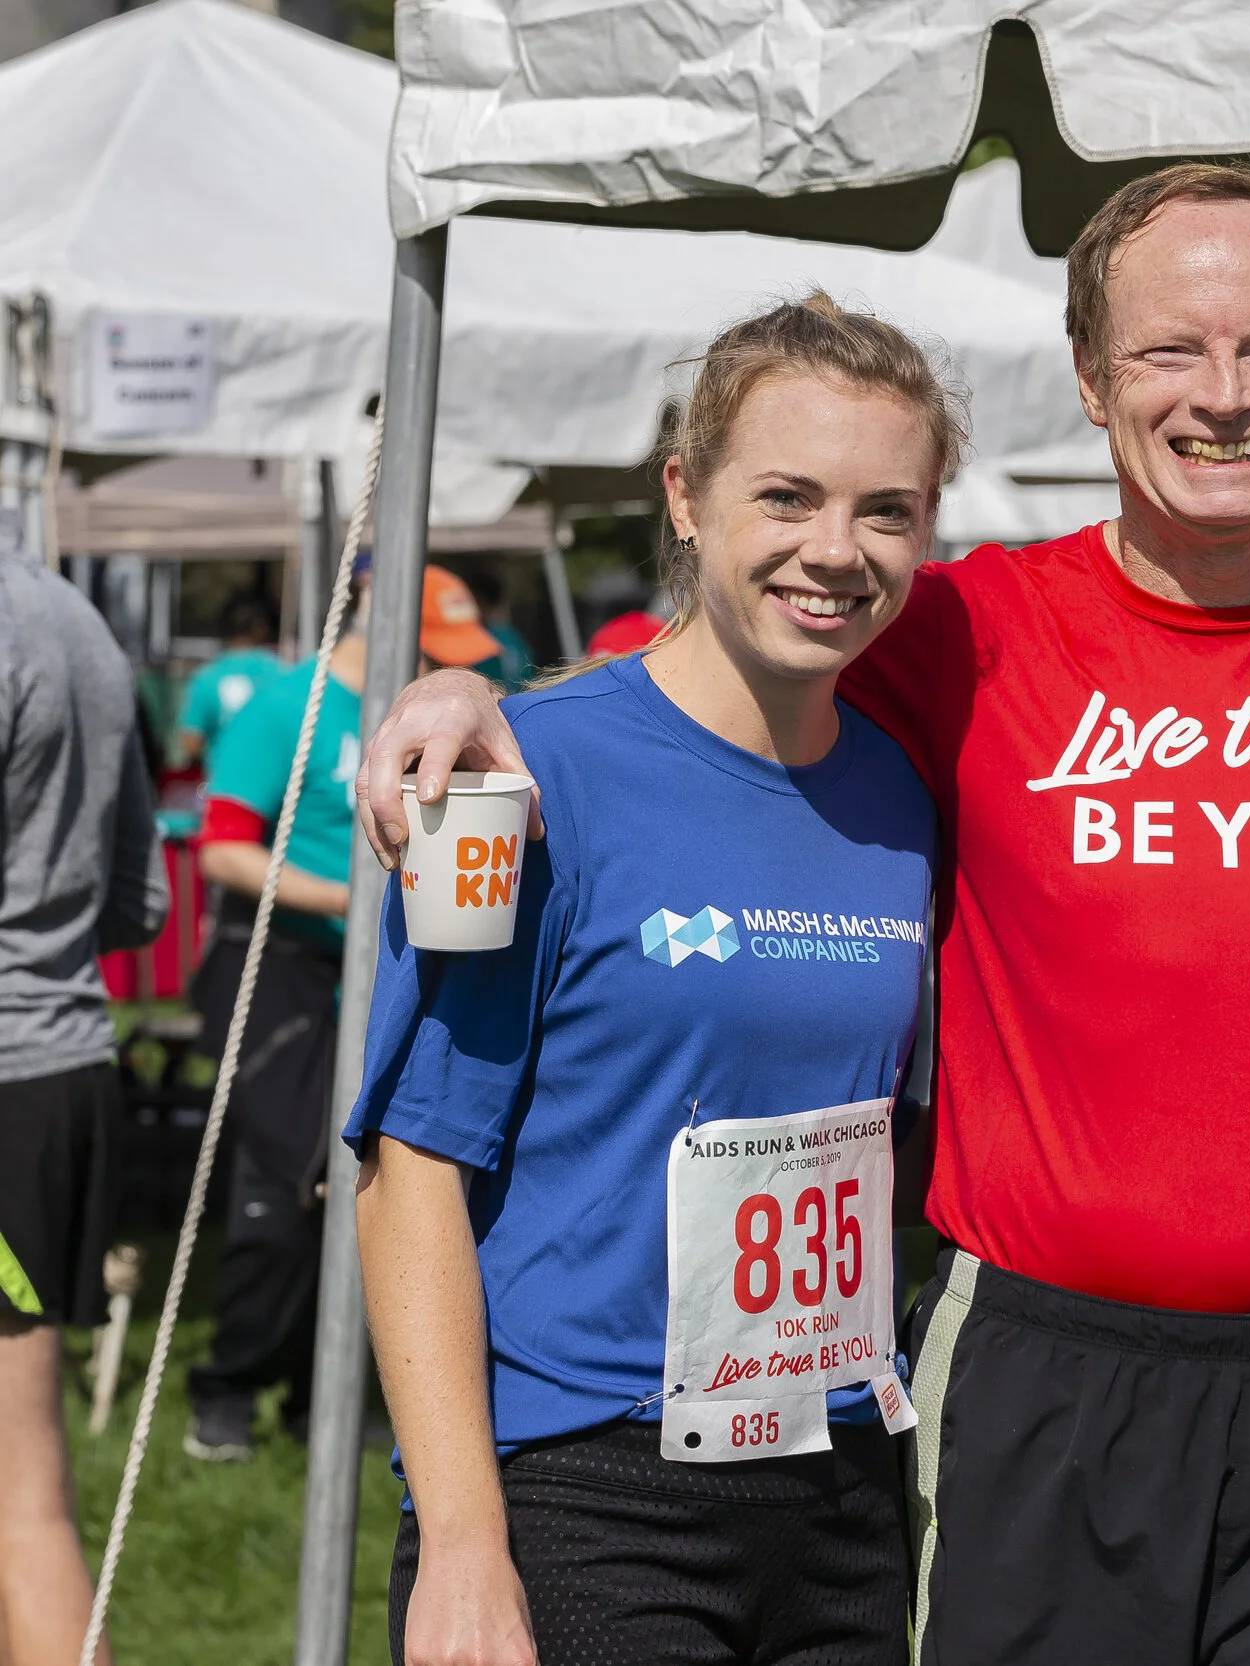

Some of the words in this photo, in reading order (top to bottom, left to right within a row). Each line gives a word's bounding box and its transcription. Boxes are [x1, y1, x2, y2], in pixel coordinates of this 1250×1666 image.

[1026, 690, 1208, 791] Live
[1073, 796, 1174, 865] BE
[456, 833, 518, 871] DN
[741, 908, 821, 935] MARSH
[823, 913, 840, 936] &
[750, 936, 880, 964] COMPANIES
[691, 1138, 739, 1159] AIDS
[744, 1137, 782, 1157] RUN
[785, 1135, 796, 1153] &
[799, 1129, 831, 1150] WALK
[834, 1119, 887, 1143] CHICAGO
[780, 1156, 819, 1172] OCTOBER
[733, 1178, 863, 1314] 835
[775, 1319, 806, 1339] 10K
[812, 1311, 840, 1334] RUN
[703, 1353, 762, 1393] Live
[819, 1346, 840, 1371] BE
[841, 1334, 877, 1361] YOU.
[731, 1411, 779, 1447] 835
